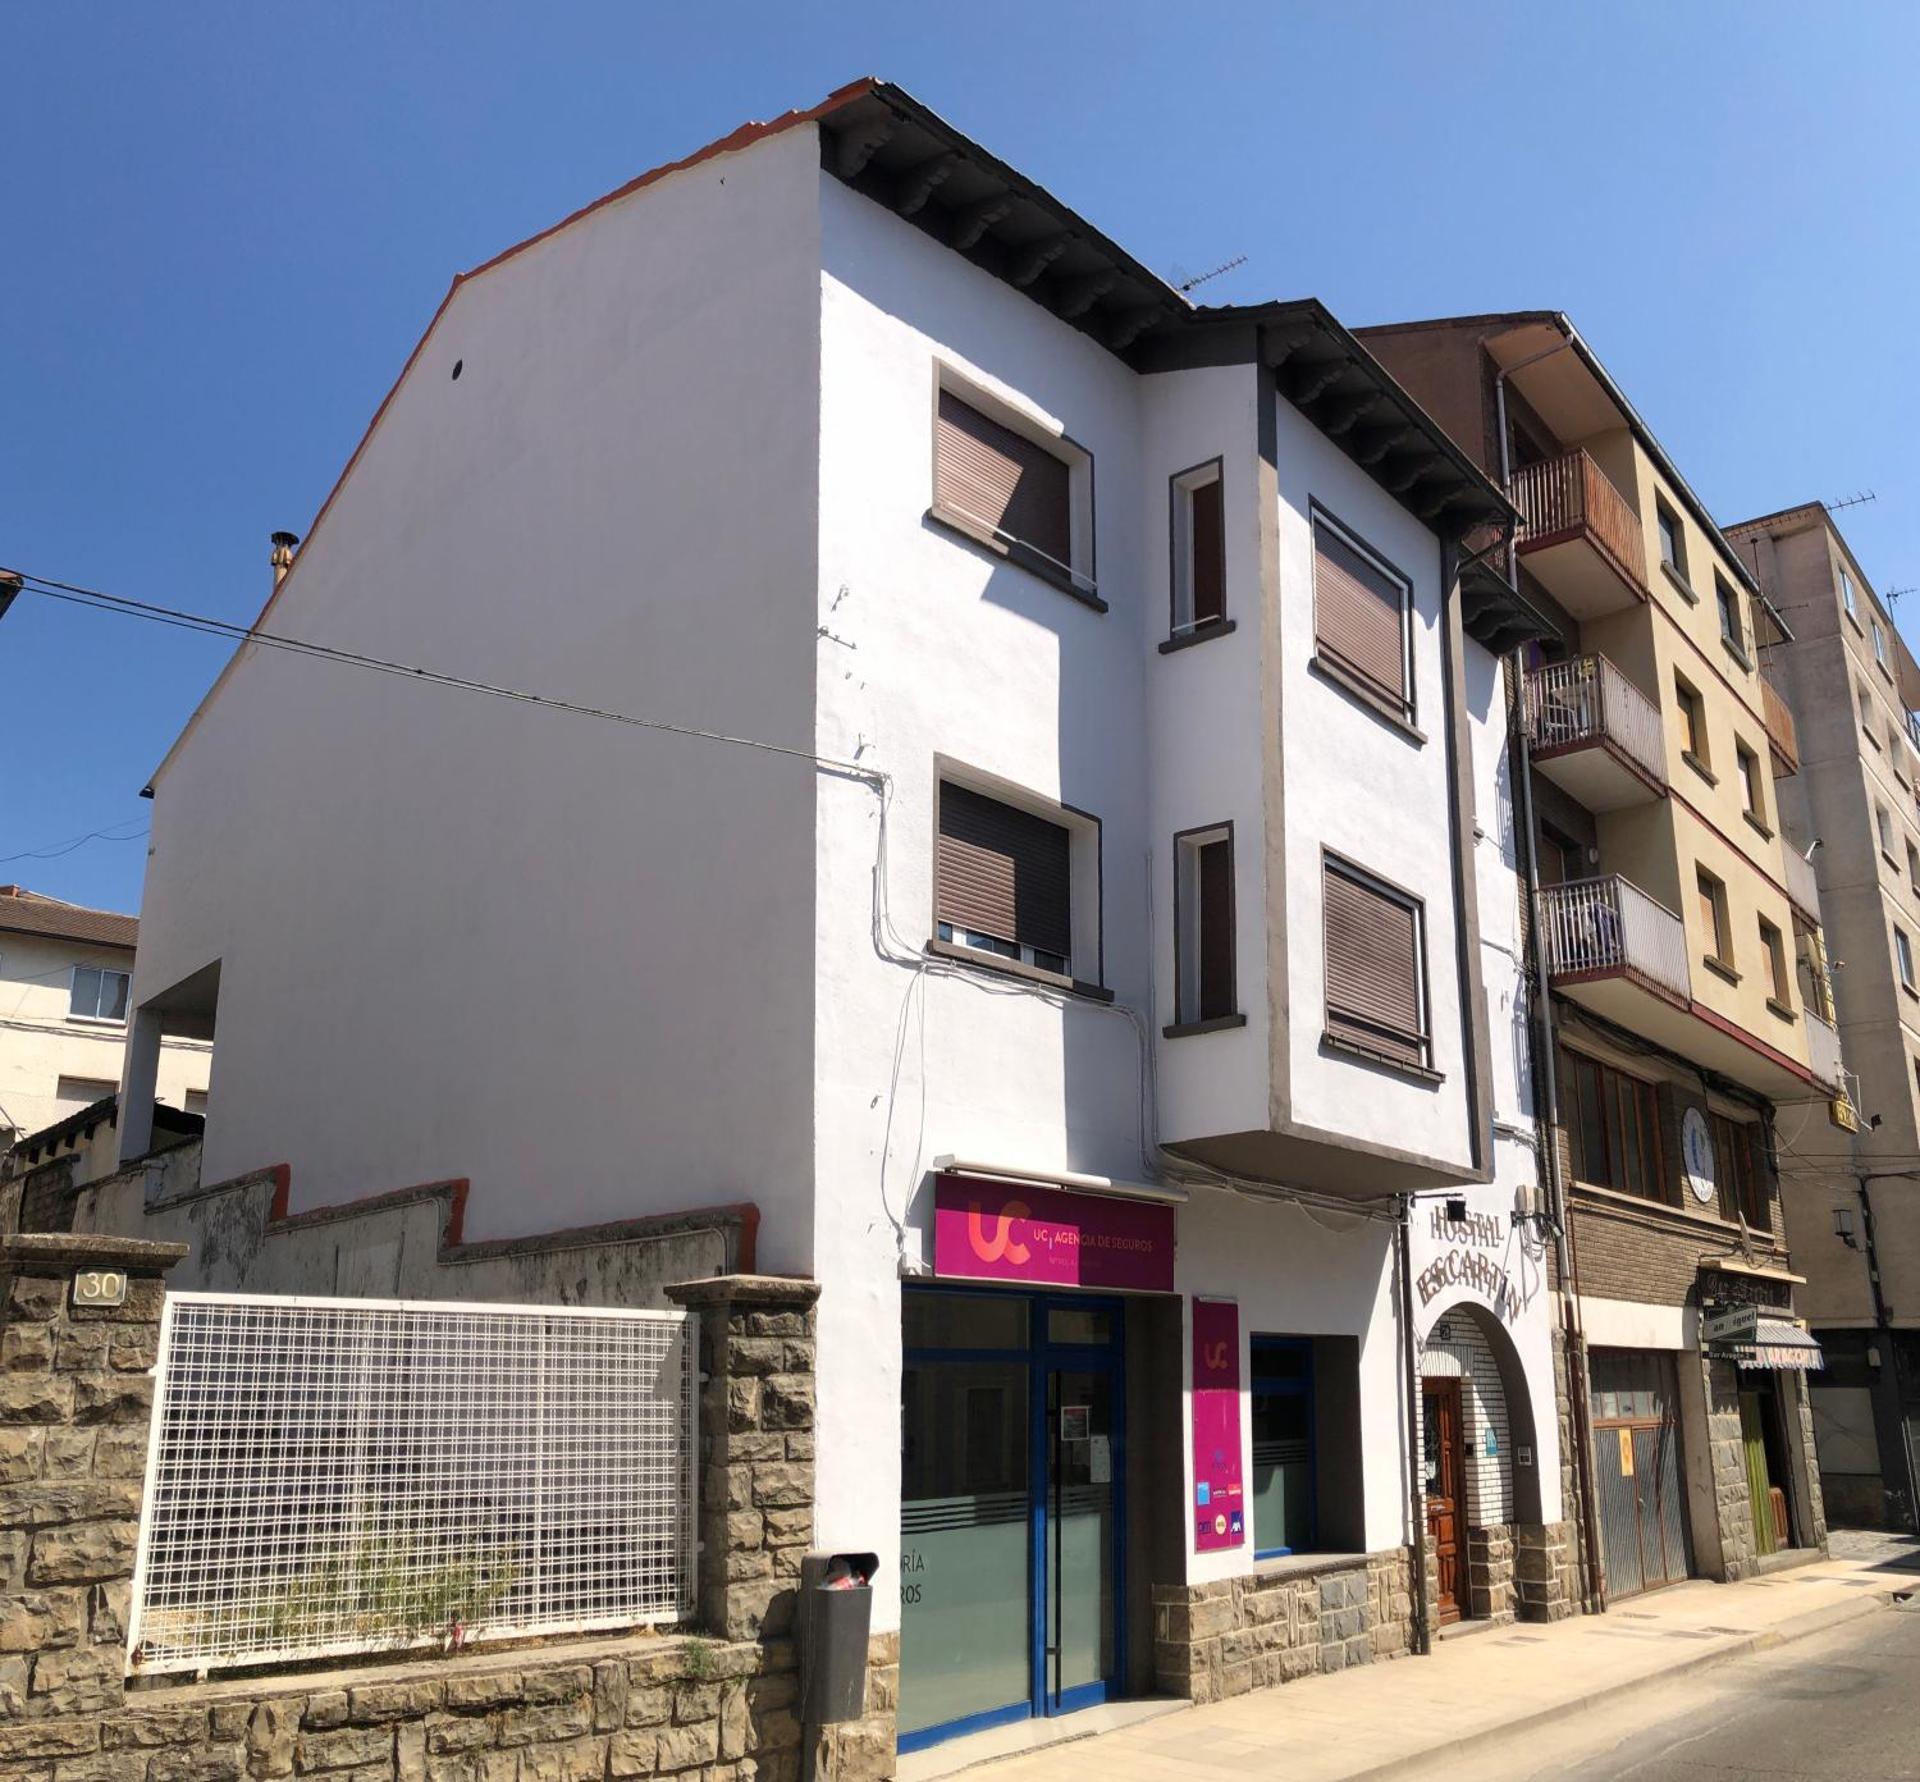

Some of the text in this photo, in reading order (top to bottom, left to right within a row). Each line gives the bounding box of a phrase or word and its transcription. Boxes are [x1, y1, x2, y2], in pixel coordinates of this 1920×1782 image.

[1033, 1229, 1048, 1241] UC
[1054, 1231, 1096, 1248] AGENCIA
[1098, 1235, 1111, 1249] DE
[83, 1272, 120, 1298] 30
[1416, 1249, 1522, 1326] ESCARTN
[900, 1548, 925, 1573] RÍA
